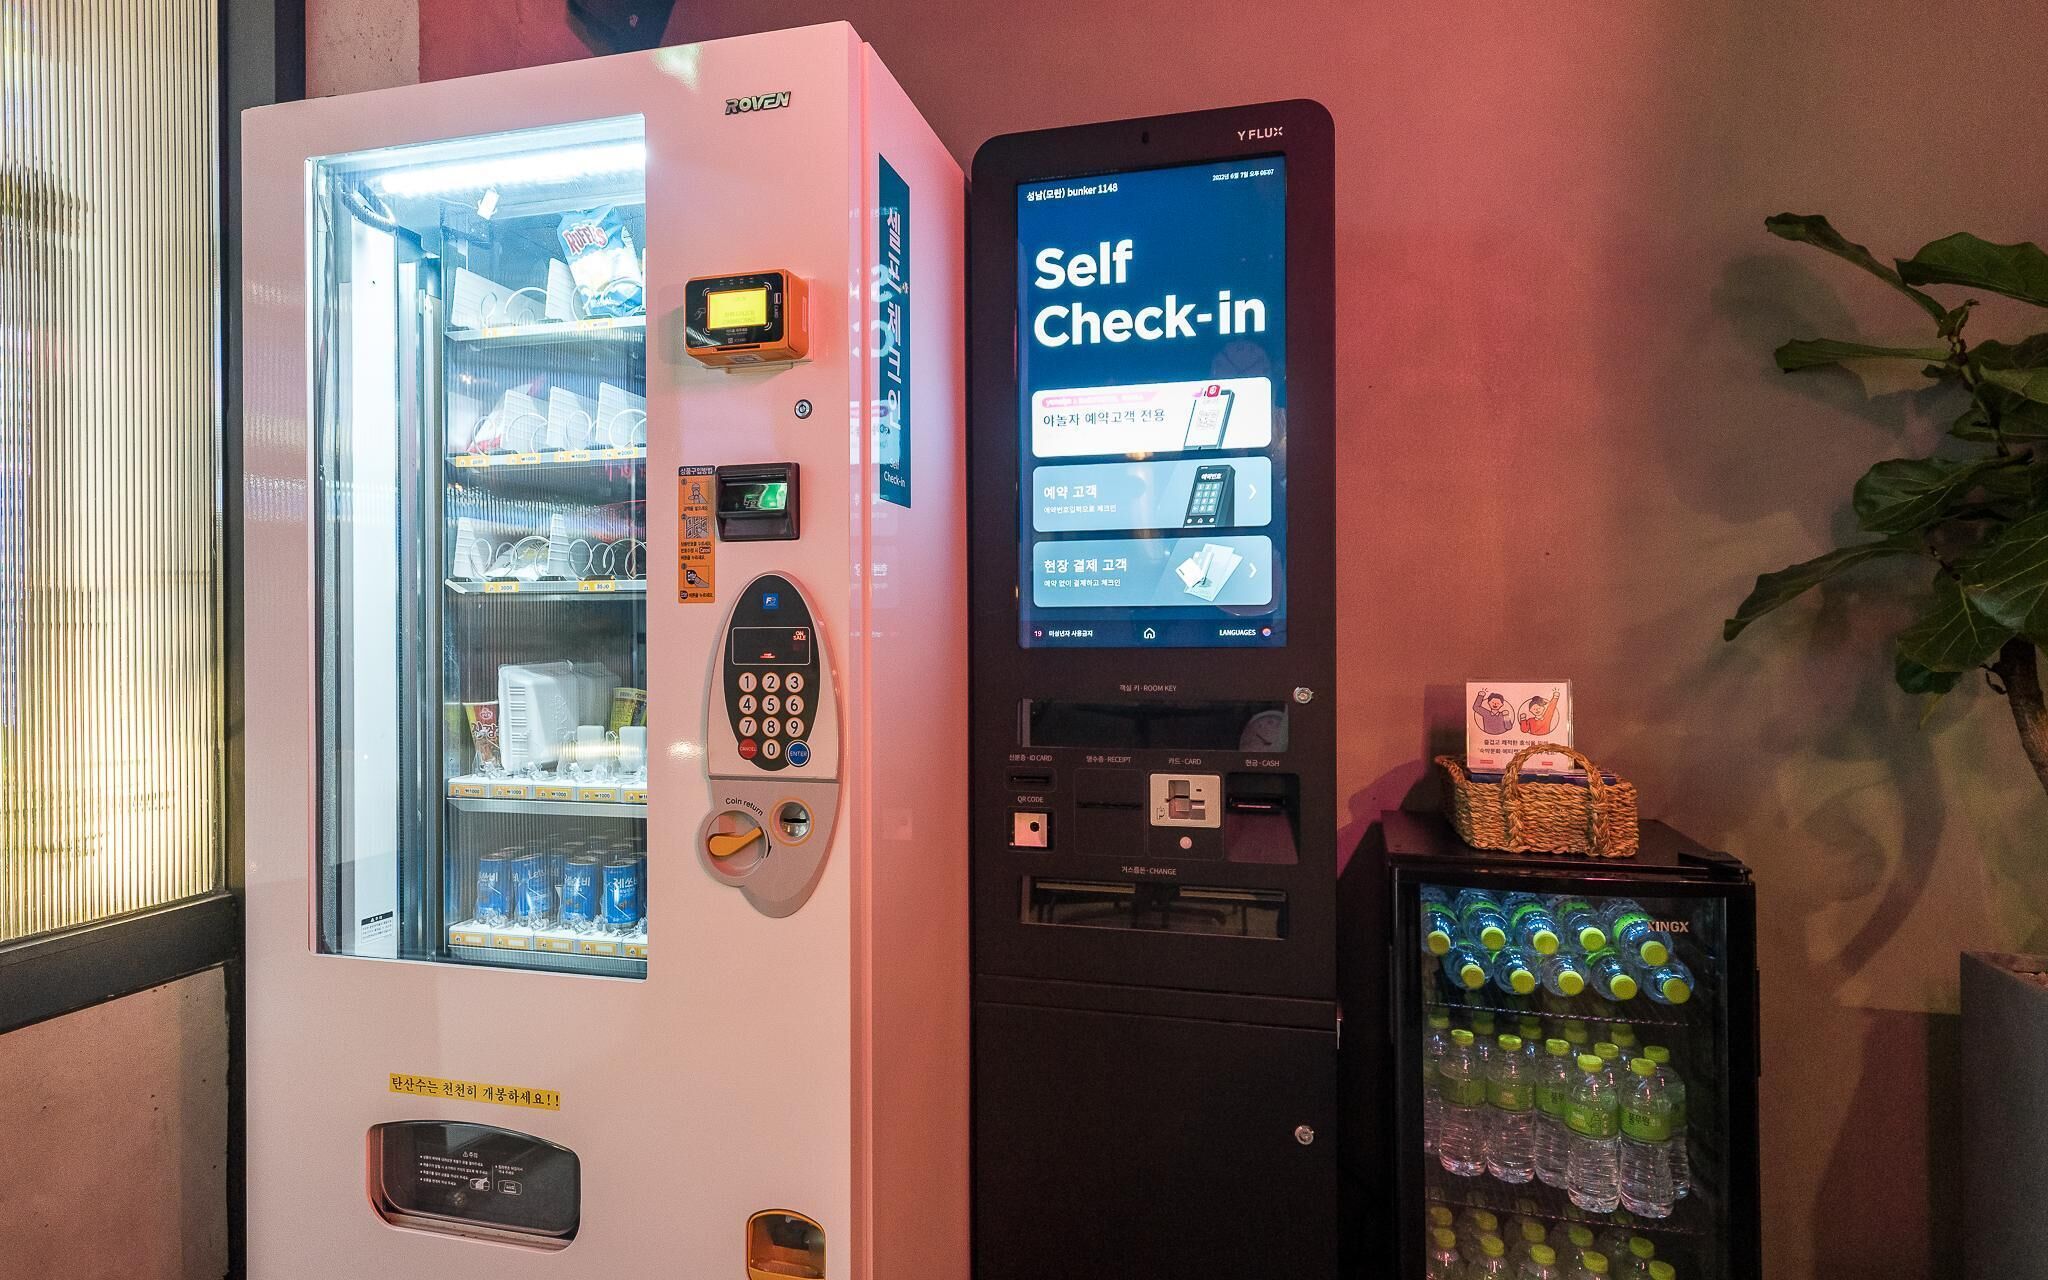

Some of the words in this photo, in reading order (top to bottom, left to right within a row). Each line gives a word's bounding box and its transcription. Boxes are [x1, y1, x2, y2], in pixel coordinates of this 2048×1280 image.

[725, 91, 791, 115] ROVEN
[1248, 126, 1283, 140] FLUX
[1026, 187, 1065, 201] 성남(모란)
[1067, 185, 1096, 197] bunker
[1097, 182, 1118, 194] 1148
[1034, 239, 1133, 290] Self
[1034, 290, 1266, 347] Check-in
[1043, 412, 1080, 428] 야놀자
[1084, 410, 1135, 425] 예약고객
[1140, 408, 1165, 423] 전용
[883, 470, 906, 488] Check-in
[1043, 485, 1069, 500] 예약
[1072, 484, 1097, 499] 고객
[1043, 559, 1070, 574] 현장
[1073, 558, 1098, 573] 결제
[1102, 557, 1127, 572] 고객
[1043, 579, 1057, 587] 예약
[1058, 579, 1072, 587] 없이
[1073, 579, 1100, 587] 결제하고
[1101, 578, 1121, 587] 체크인
[744, 676, 750, 689] 1
[767, 675, 775, 689] 2
[790, 675, 799, 689] 3
[1164, 684, 1177, 692] KEY
[742, 698, 752, 711] 4
[767, 698, 775, 711] 5
[790, 698, 799, 711] 6
[744, 720, 752, 733] 7
[767, 720, 775, 734] 8
[790, 720, 799, 734] 9
[767, 742, 776, 756] 0
[1036, 754, 1053, 762] CARD
[1017, 795, 1027, 803] QR
[1027, 795, 1044, 803] CODE
[725, 797, 742, 805] Coin
[743, 800, 764, 817] return
[1647, 921, 1689, 933] KINGX
[391, 1076, 439, 1095] 탄산수는
[442, 1081, 477, 1099] 천천히
[482, 1086, 559, 1107] 개봉하세요!!
